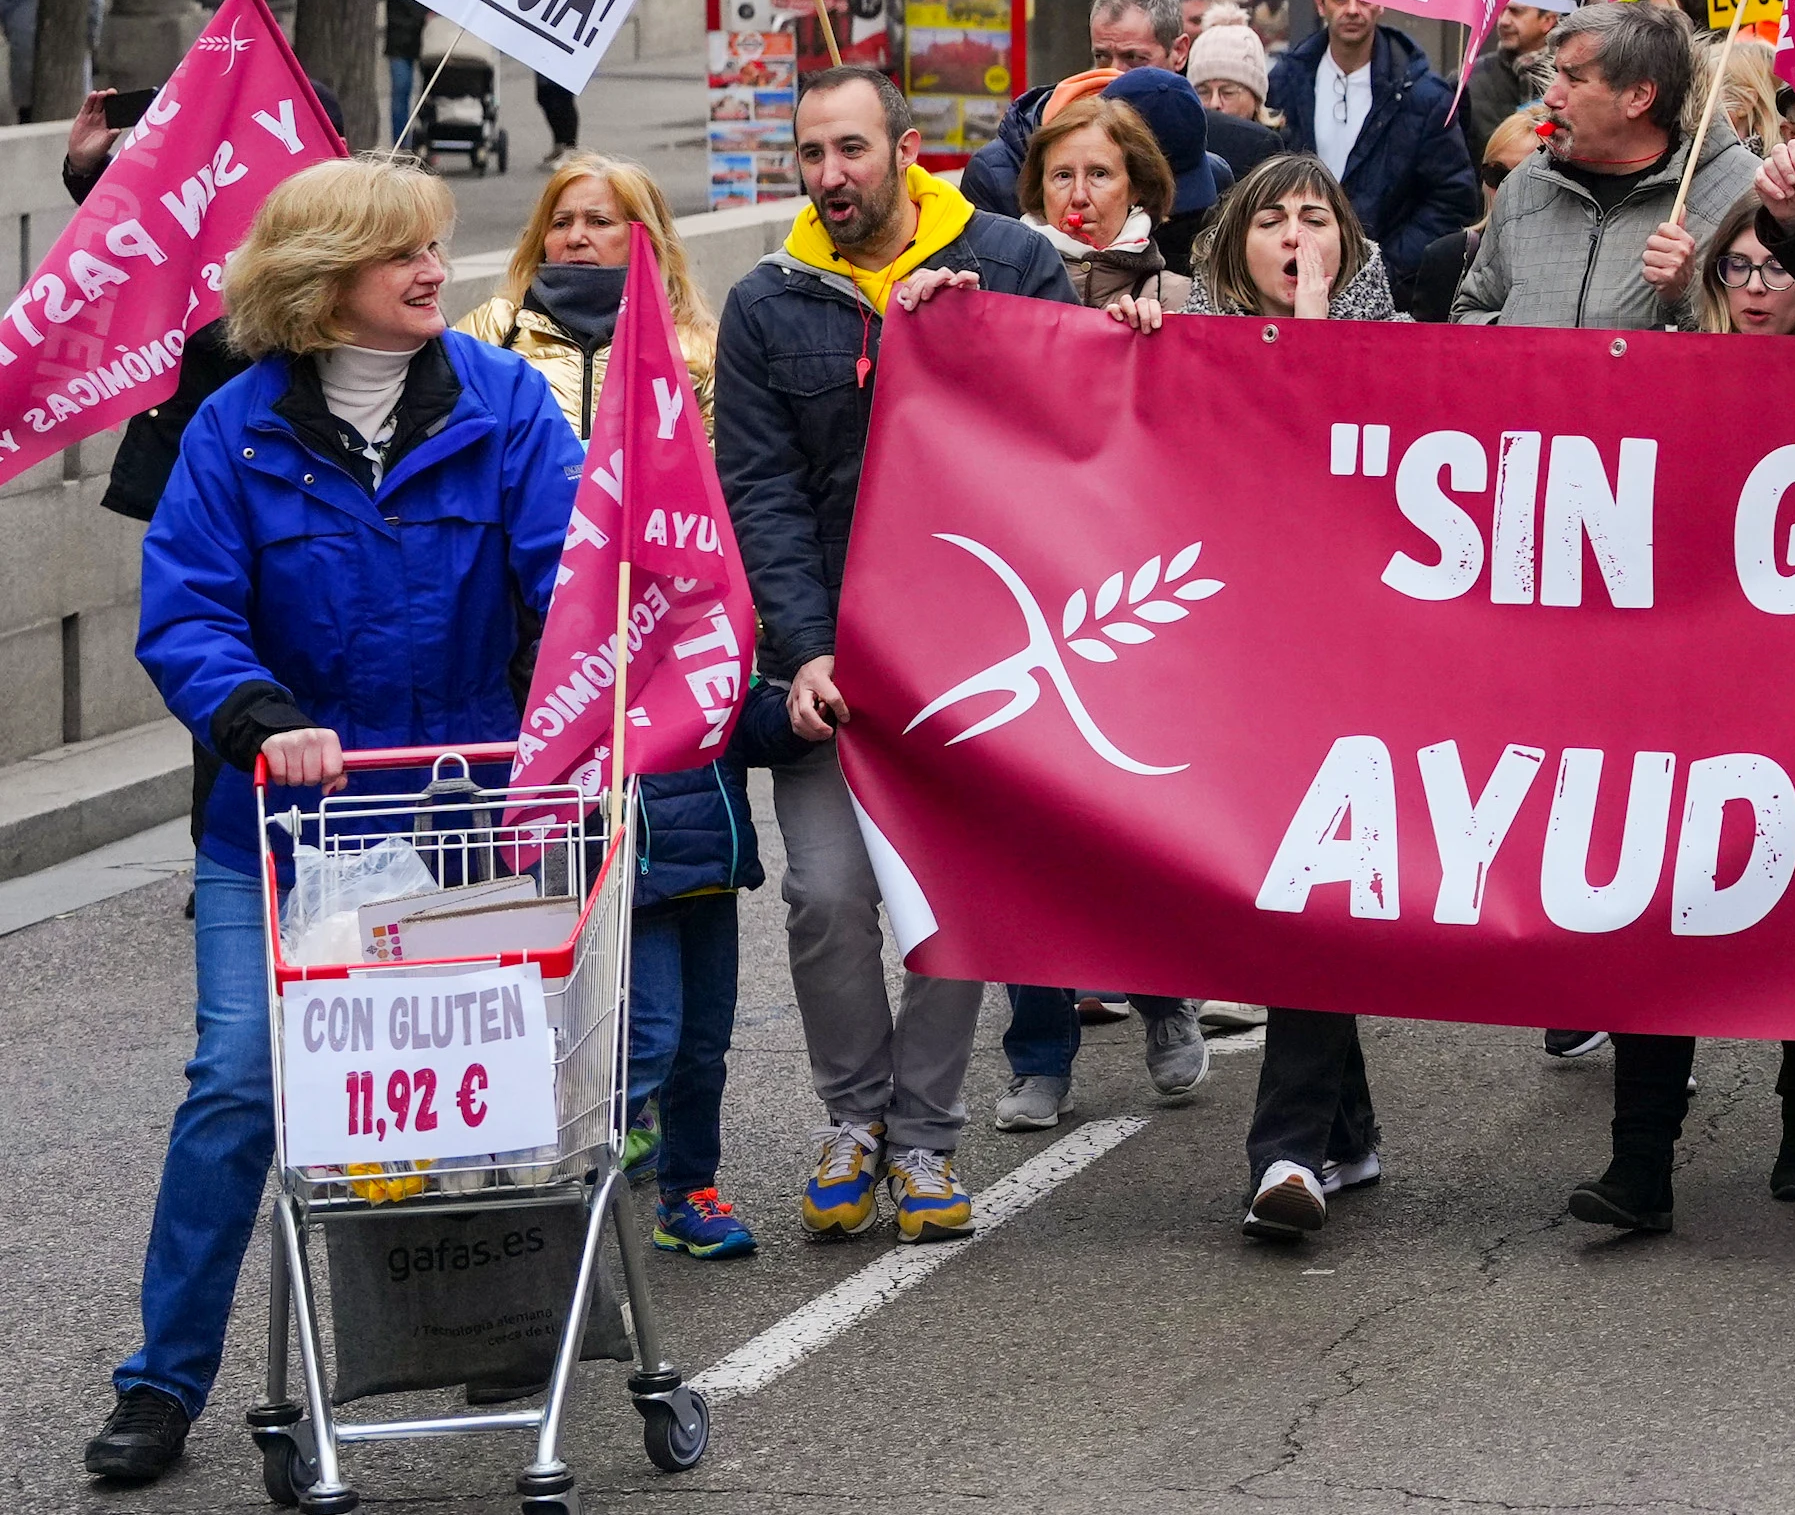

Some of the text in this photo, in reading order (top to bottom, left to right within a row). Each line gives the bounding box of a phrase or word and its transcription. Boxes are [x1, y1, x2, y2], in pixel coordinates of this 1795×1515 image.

[651, 377, 684, 441] Y
[1331, 423, 1657, 608] "SIN
[303, 983, 526, 1054] CON GLUTEN
[344, 1062, 489, 1143] 11,92 €
[387, 1226, 545, 1283] gafas.es
